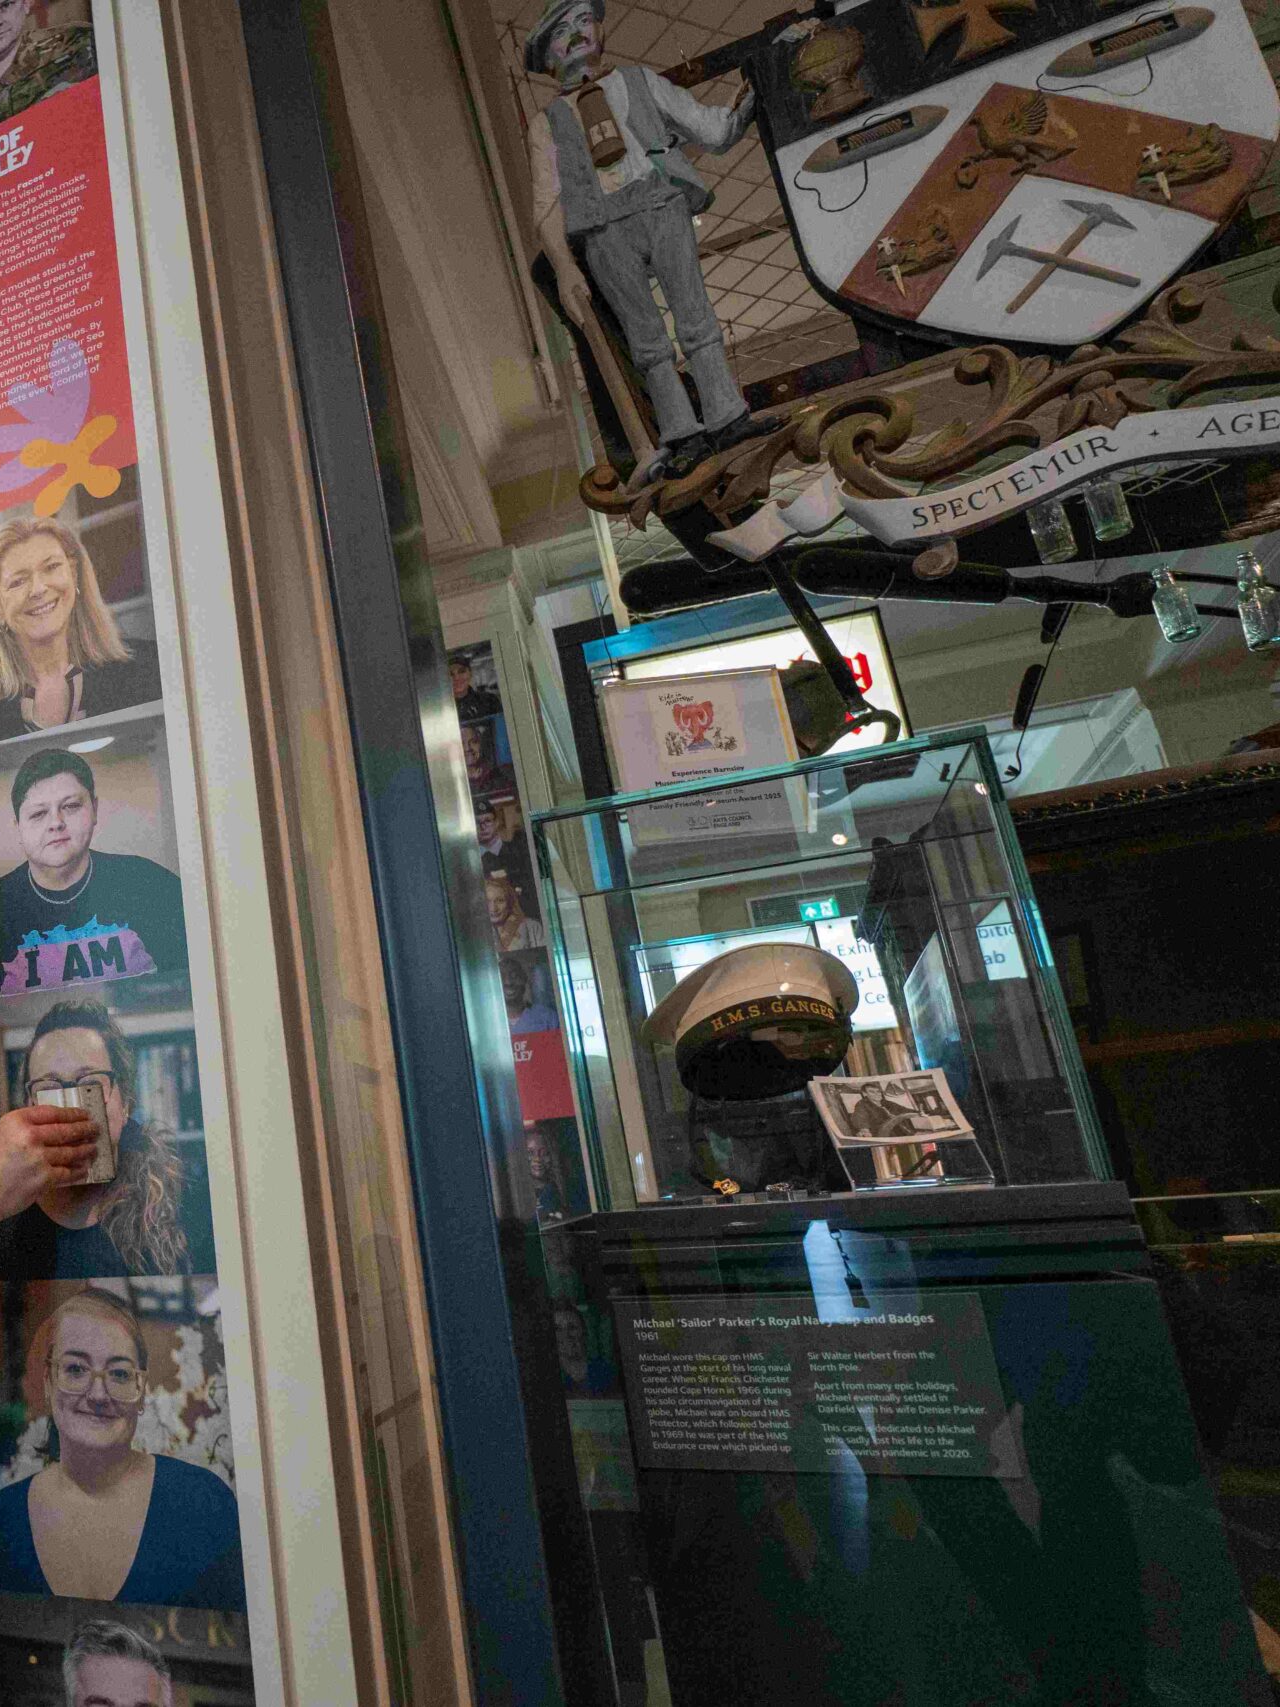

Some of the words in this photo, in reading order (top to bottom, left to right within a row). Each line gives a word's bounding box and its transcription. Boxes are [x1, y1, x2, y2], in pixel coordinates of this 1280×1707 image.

[912, 435, 1119, 530] SPECTEMUR
[671, 769, 712, 778] Experience
[713, 765, 745, 774] Barnsley
[649, 802, 673, 811] Family
[675, 799, 704, 809] Friendly
[738, 794, 762, 802] Award
[764, 792, 781, 800] 2025
[25, 949, 41, 988] I
[62, 936, 126, 981] AM
[710, 1004, 765, 1032] H.M.S.
[771, 1000, 835, 1020] GANGES
[633, 1319, 675, 1328] Michael
[768, 1317, 800, 1328] Royal
[863, 1315, 885, 1324] and
[888, 1314, 935, 1326] Badges
[635, 1332, 658, 1340] 1961
[712, 1355, 728, 1363] cap
[640, 1365, 670, 1374] Ganges
[746, 1365, 766, 1374] long
[679, 1387, 701, 1396] Cape
[762, 1387, 792, 1397] during
[813, 1382, 839, 1391] Apart
[866, 1384, 891, 1392] many
[894, 1382, 914, 1392] epic
[719, 1420, 756, 1428] followed
[882, 1449, 928, 1458] pandemic
[930, 1450, 940, 1458] in
